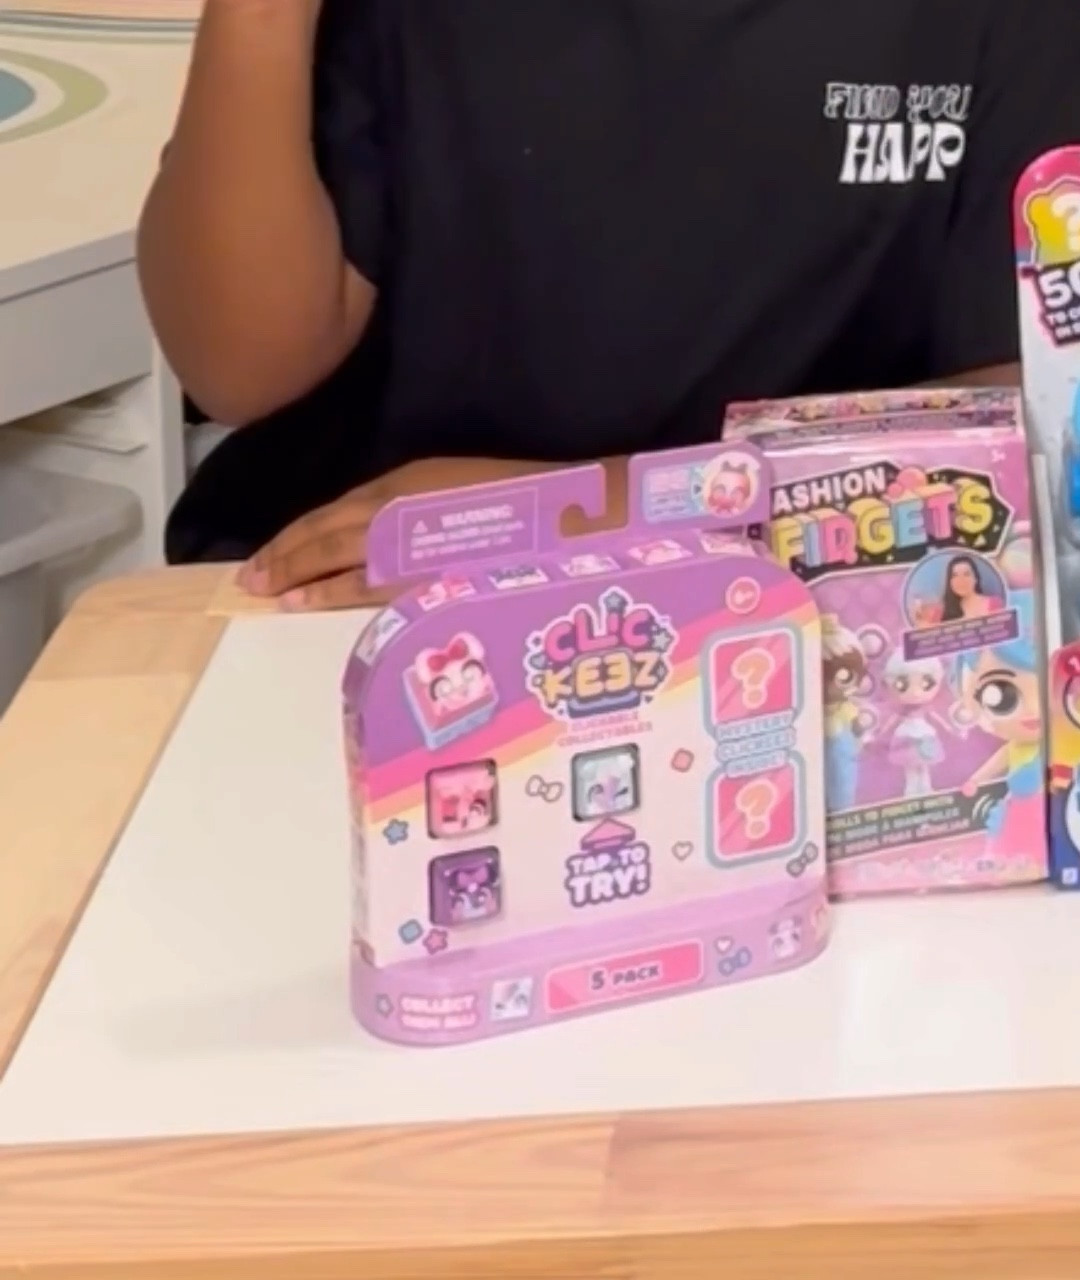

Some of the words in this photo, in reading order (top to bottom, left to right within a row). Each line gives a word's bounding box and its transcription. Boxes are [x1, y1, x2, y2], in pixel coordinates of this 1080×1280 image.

[823, 82, 900, 120] FIND
[906, 84, 972, 124] YOU
[838, 122, 966, 184] HAPP
[773, 466, 886, 515] ASHION
[771, 477, 994, 571] FIDGETS
[568, 852, 611, 874] TAP
[617, 844, 646, 866] TO
[568, 862, 647, 903] TRY!
[590, 970, 605, 990] 5
[612, 965, 660, 986] PACK
